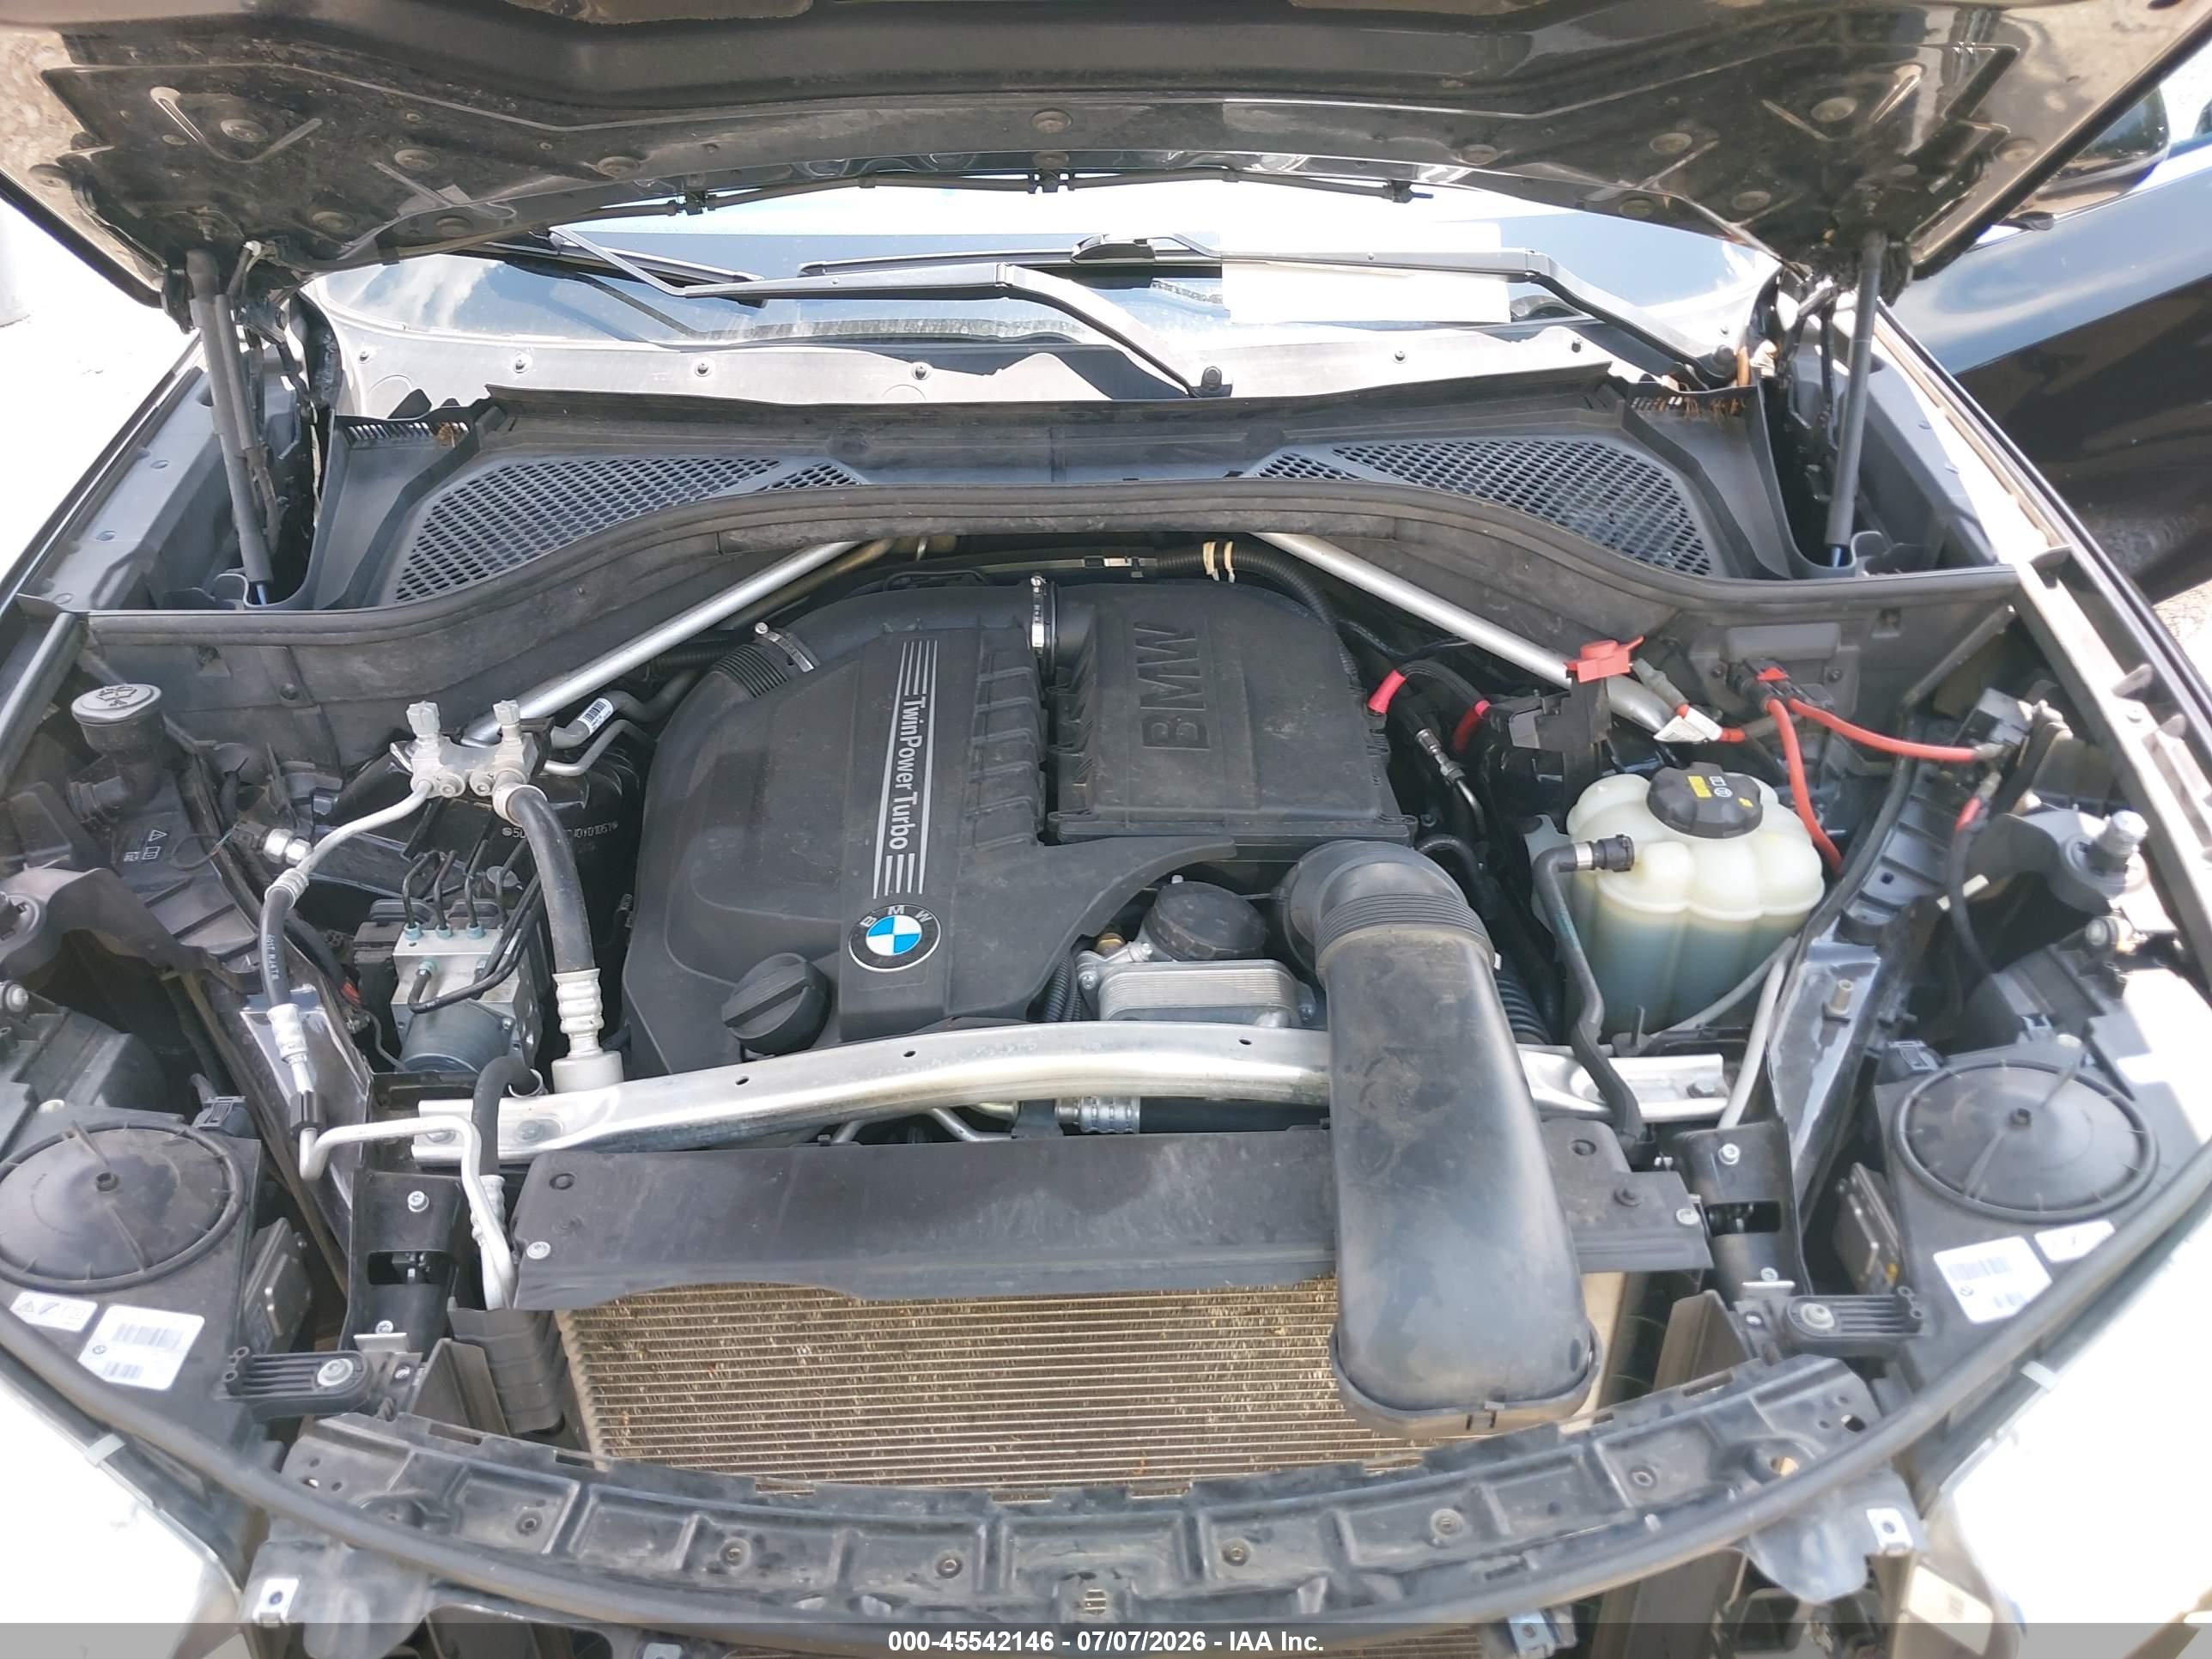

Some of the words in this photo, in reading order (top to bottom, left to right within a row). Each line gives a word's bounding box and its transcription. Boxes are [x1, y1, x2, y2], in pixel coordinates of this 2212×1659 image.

[1133, 621, 1210, 750] BMW
[890, 696, 927, 790] TwinPower
[888, 792, 918, 851] Turbo
[860, 904, 932, 928] BMW
